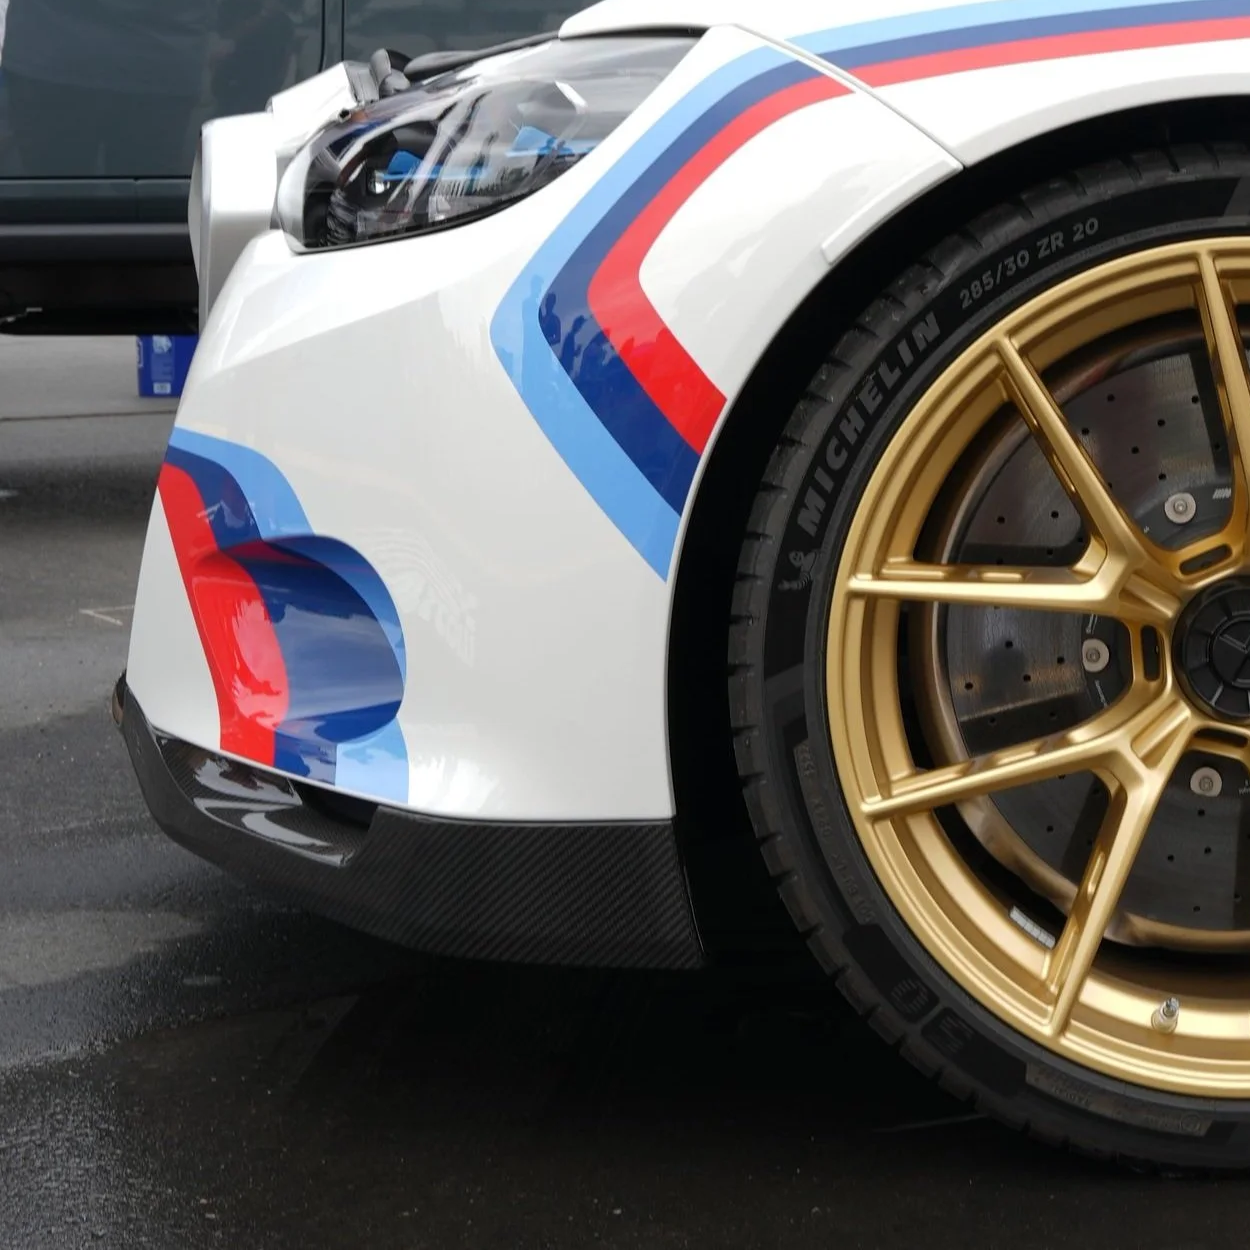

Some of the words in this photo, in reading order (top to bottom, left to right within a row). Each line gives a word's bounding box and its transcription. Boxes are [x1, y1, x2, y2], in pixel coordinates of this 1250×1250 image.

[959, 249, 1030, 309] 285/30
[1036, 230, 1065, 259] ZR
[1072, 217, 1100, 243] 20
[797, 310, 942, 539] MICHELIN
